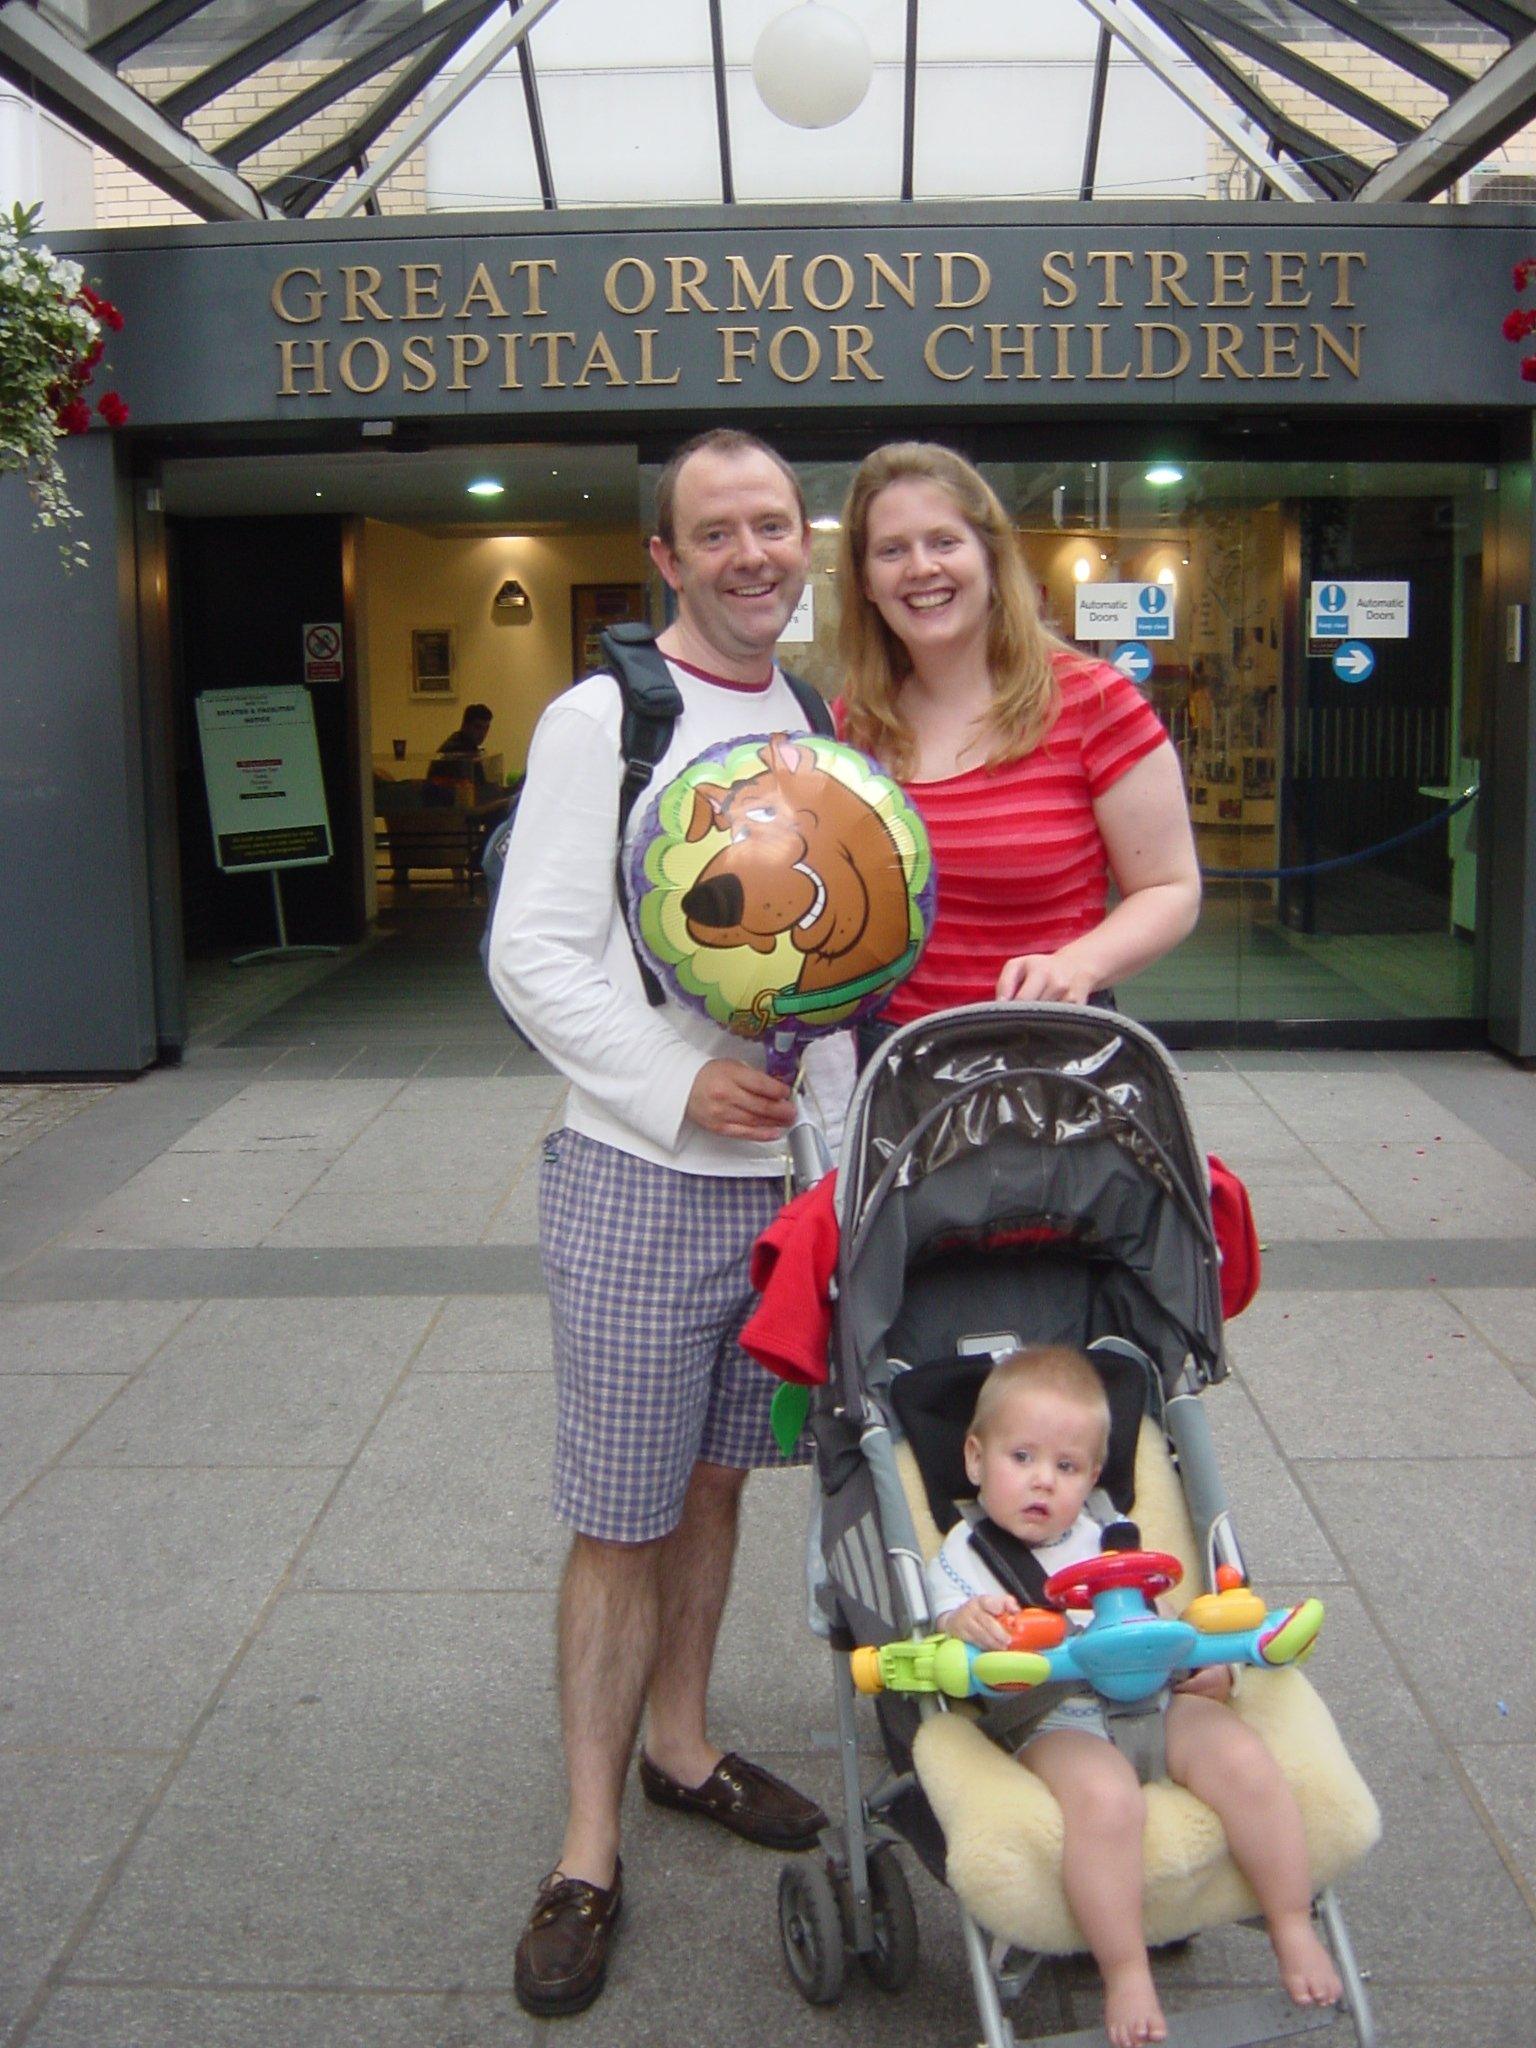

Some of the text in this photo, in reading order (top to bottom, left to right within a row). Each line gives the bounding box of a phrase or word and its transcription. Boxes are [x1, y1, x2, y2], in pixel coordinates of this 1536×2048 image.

[271, 250, 1368, 324] GREAT ORMOND STREET
[276, 322, 1368, 396] HOSPITAL FOR CHILDREN
[1080, 600, 1128, 610] Automatic
[1356, 599, 1404, 608] Automatic
[1089, 612, 1119, 622] Doors
[1366, 610, 1395, 620] Doors
